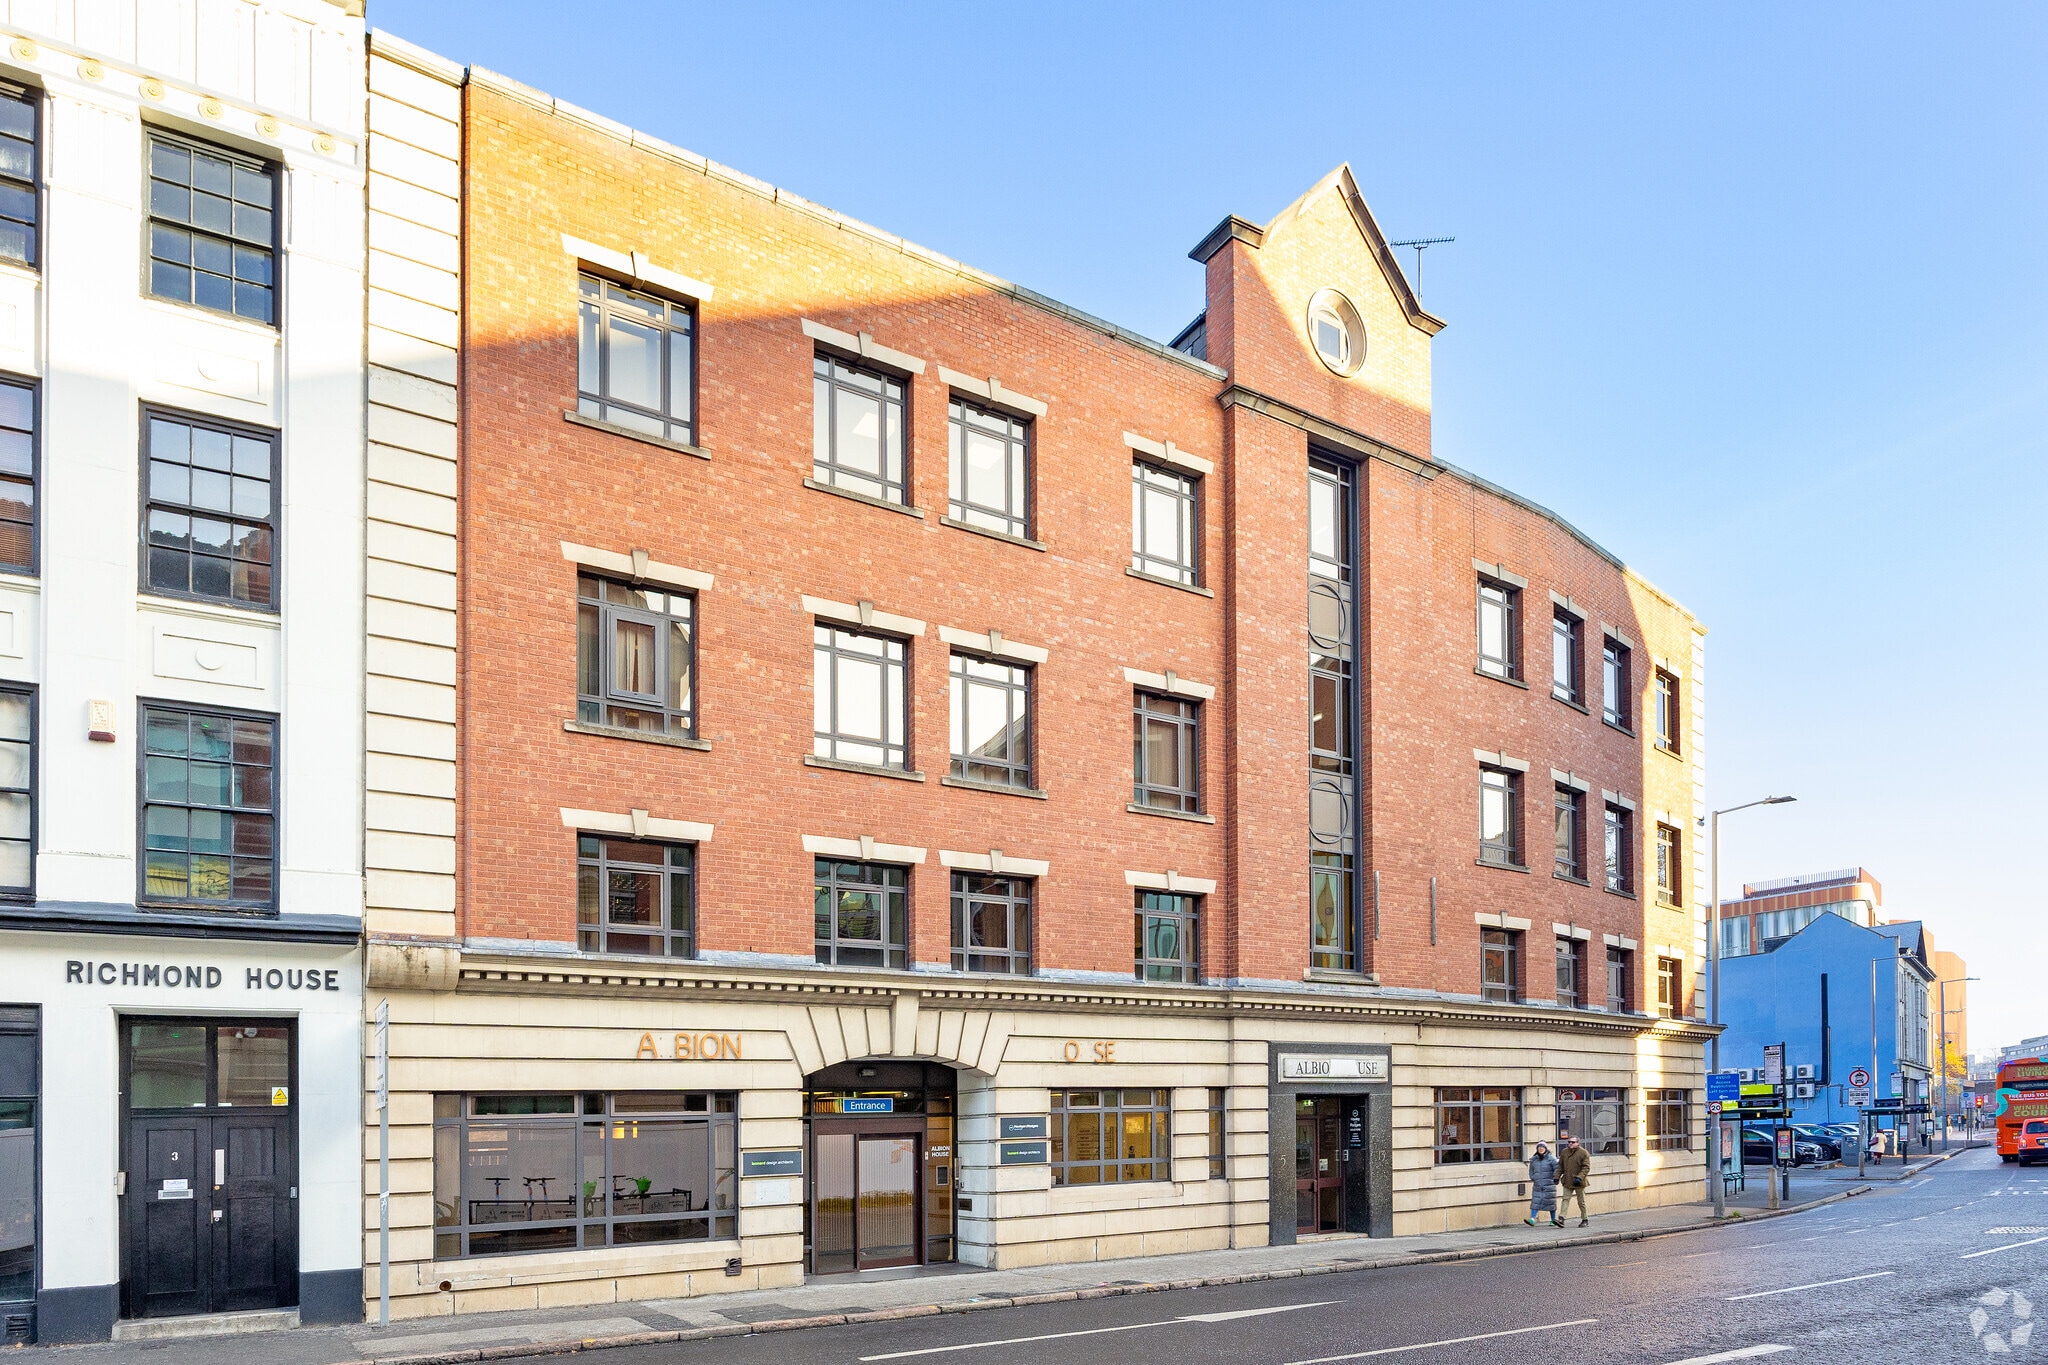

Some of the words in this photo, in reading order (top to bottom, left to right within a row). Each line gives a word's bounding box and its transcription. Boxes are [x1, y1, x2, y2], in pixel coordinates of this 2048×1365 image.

[66, 960, 222, 988] RICHMOND
[246, 967, 339, 991] HOUSE
[1296, 1061, 1331, 1075] ALBIO
[850, 1101, 886, 1110] Entrance
[171, 1151, 179, 1161] 3
